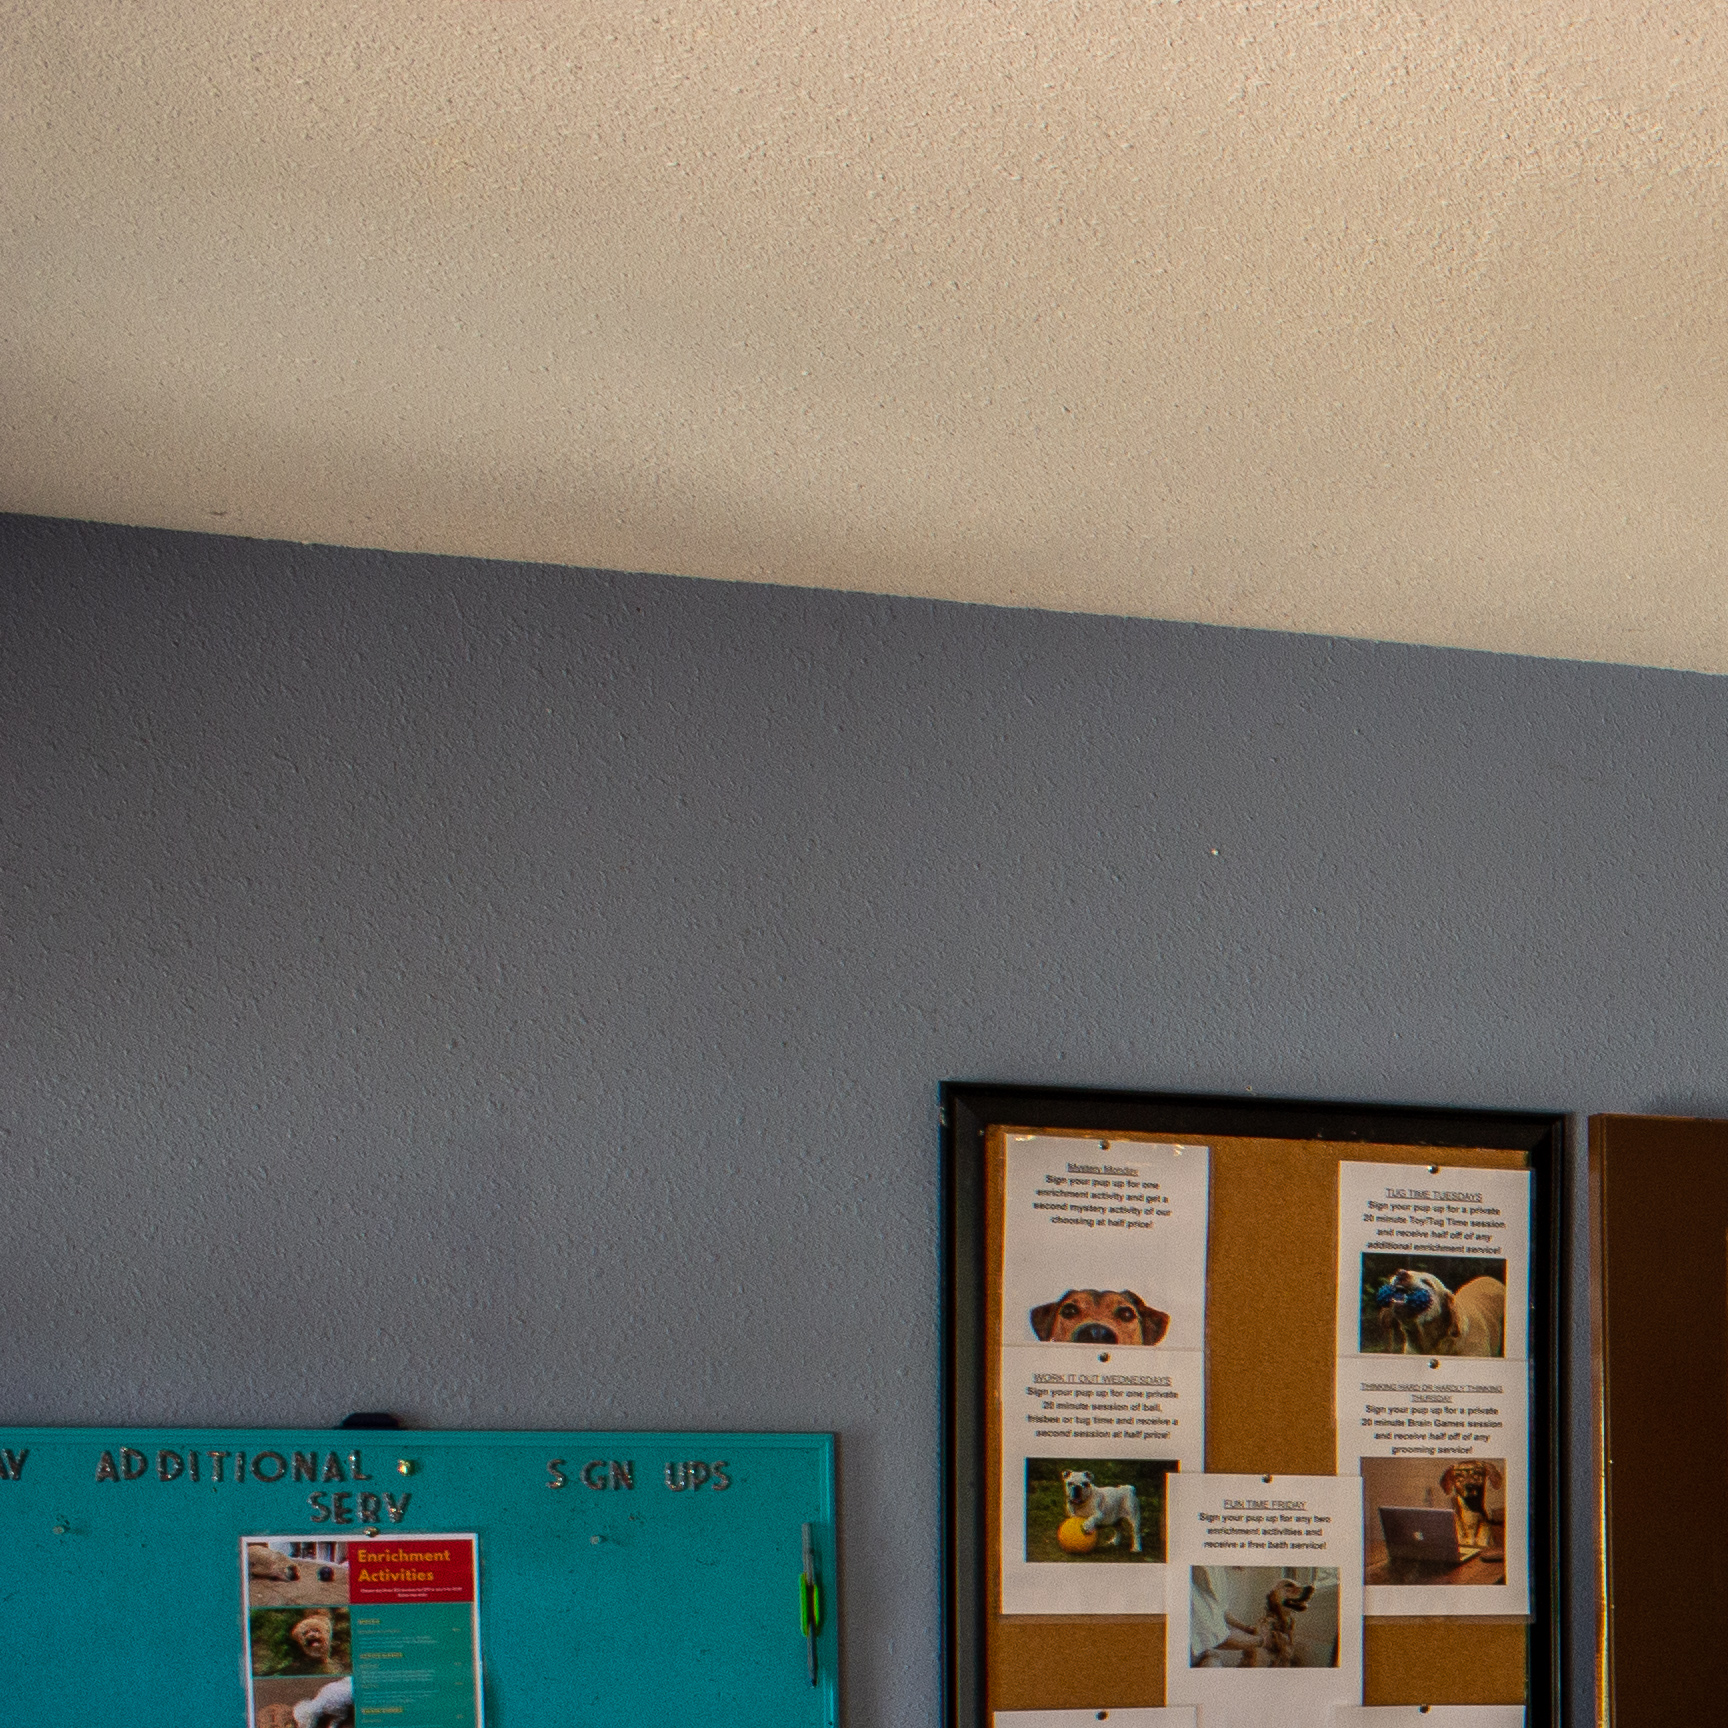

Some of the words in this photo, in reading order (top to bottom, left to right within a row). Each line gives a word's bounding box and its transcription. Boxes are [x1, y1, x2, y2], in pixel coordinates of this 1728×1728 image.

[1368, 1200, 1388, 1210] Sign
[1390, 1202, 1411, 1212] your
[1413, 1204, 1430, 1213] pup
[1432, 1205, 1444, 1214] up
[1446, 1205, 1460, 1213] for
[1470, 1207, 1500, 1216] private
[1361, 1418, 1372, 1426] 20
[1374, 1418, 1405, 1427] minute
[1434, 1419, 1465, 1428] Games
[1467, 1420, 1502, 1428] session
[96, 1447, 372, 1483] ADDITIONAL
[664, 1460, 730, 1491] UPS
[307, 1491, 411, 1525] SERV
[1267, 1541, 1288, 1549] bath
[358, 1548, 450, 1562] Enrichment
[358, 1568, 434, 1582] Activities
